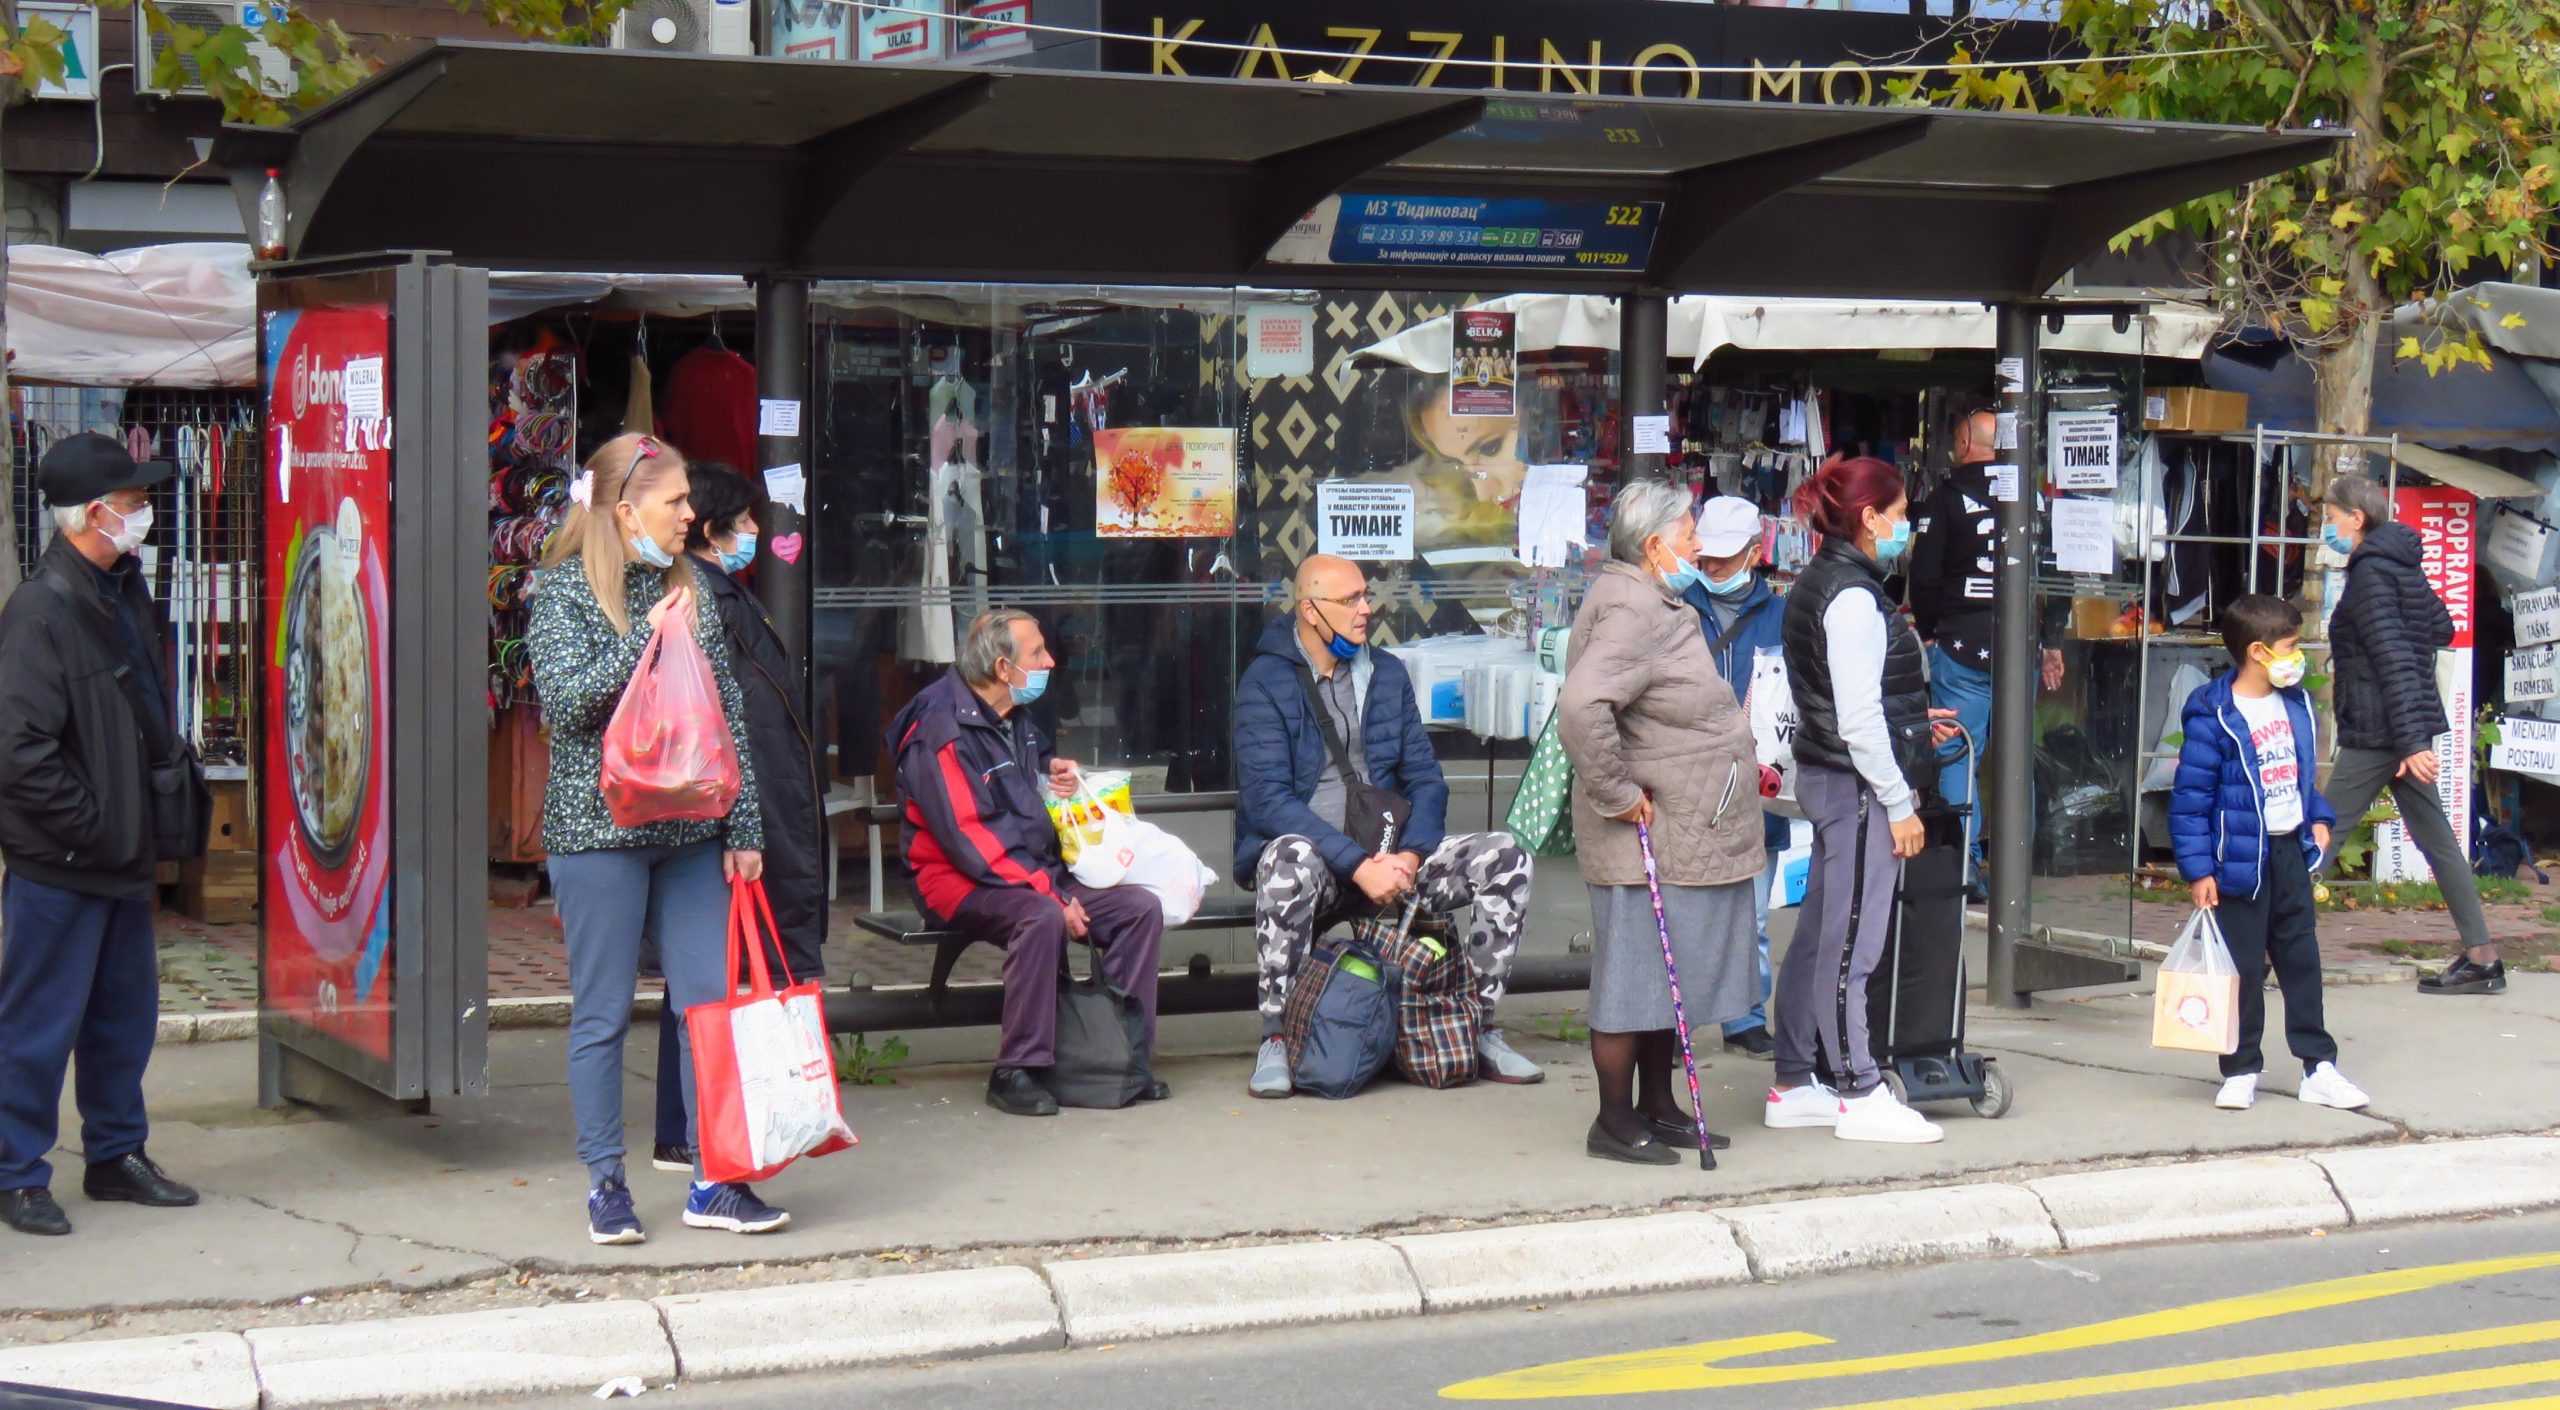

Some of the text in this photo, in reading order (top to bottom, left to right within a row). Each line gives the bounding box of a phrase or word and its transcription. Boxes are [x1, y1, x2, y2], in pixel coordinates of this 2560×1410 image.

[986, 11, 1013, 31] ULAZ
[887, 32, 912, 48] ULAZ
[1152, 17, 1699, 99] KAZZINO
[1605, 206, 1643, 226] 522
[1380, 228, 1394, 241] 23
[1399, 229, 1414, 242] 53
[1418, 229, 1434, 242] 59
[1438, 230, 1453, 242] 89
[1458, 231, 1478, 243] 534
[1377, 249, 1388, 258] За
[1390, 249, 1449, 263] информације
[1457, 252, 1492, 263] доласку
[1494, 253, 1525, 262] возила
[1525, 254, 1565, 264] позовите
[1469, 326, 1499, 337] BELKA
[2063, 445, 2110, 467] ТУМАНЕ
[1329, 515, 1402, 537] ТУМАНЕ
[2445, 502, 2470, 632] POPRAVKE
[2454, 691, 2465, 726] TAŠNE
[2511, 720, 2557, 742] MENJAM
[2506, 747, 2556, 770] POSTAVU
[2452, 776, 2464, 810] JAKNE
